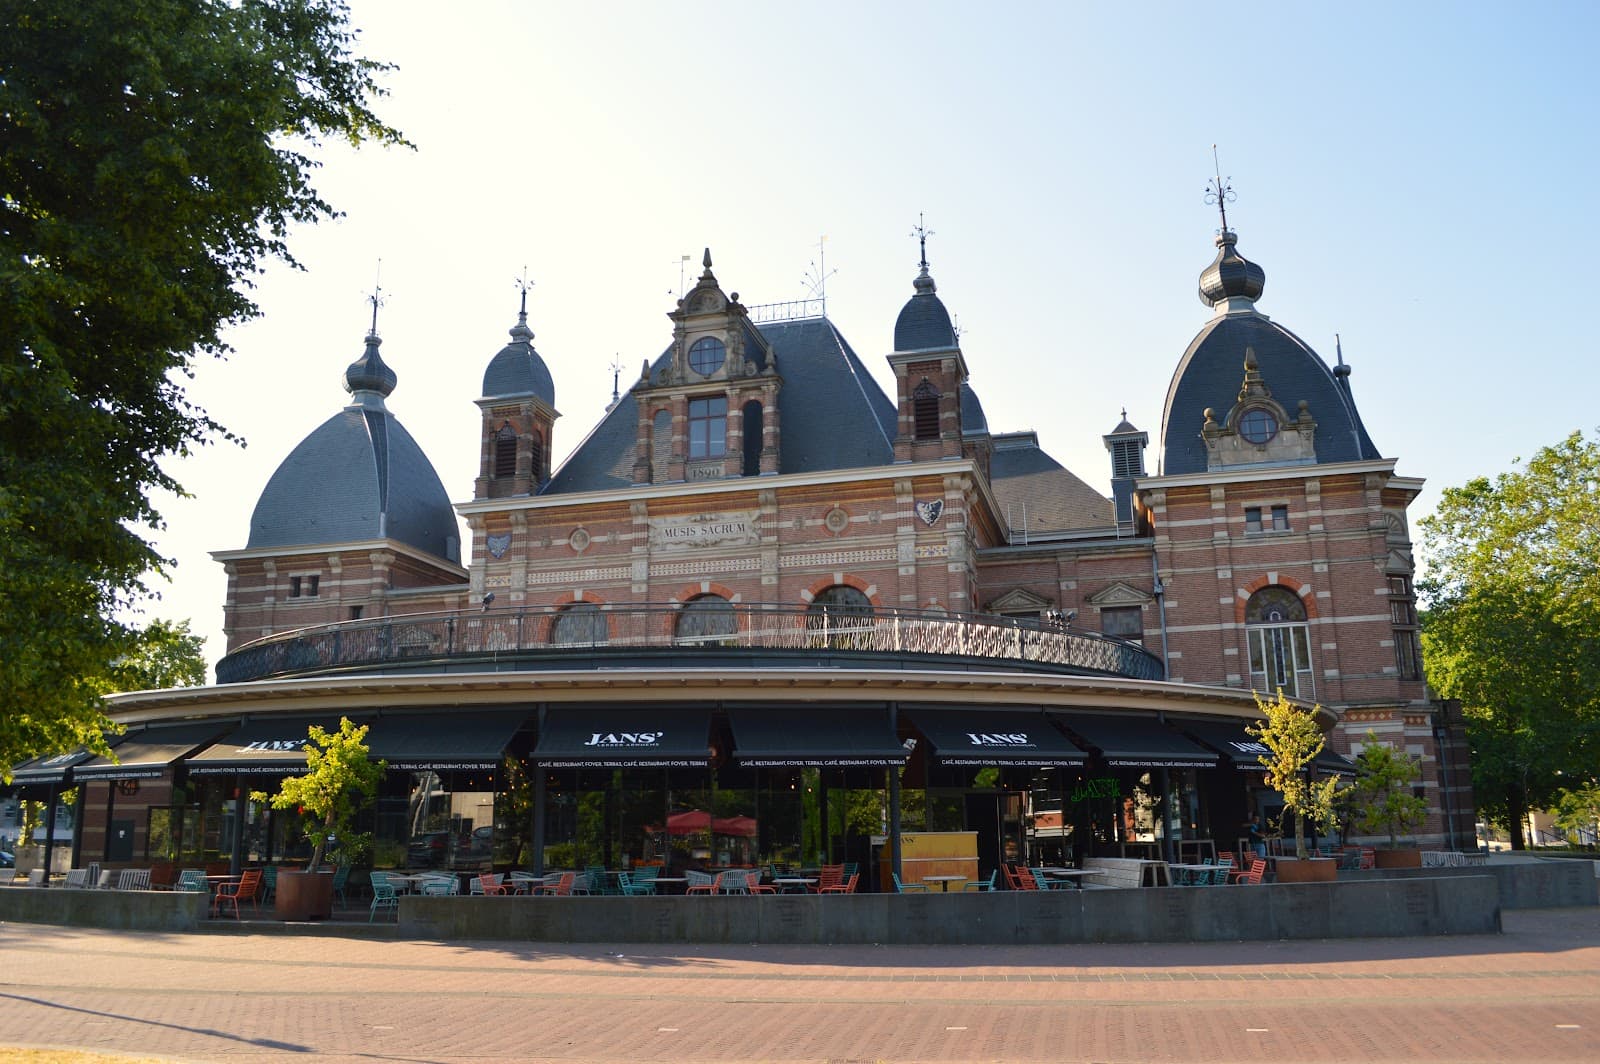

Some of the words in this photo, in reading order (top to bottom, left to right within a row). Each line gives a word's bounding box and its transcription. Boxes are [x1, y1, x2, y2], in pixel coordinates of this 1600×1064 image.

[692, 468, 720, 478] 1890
[664, 527, 696, 538] MUSIS
[701, 523, 745, 535] SACRUM
